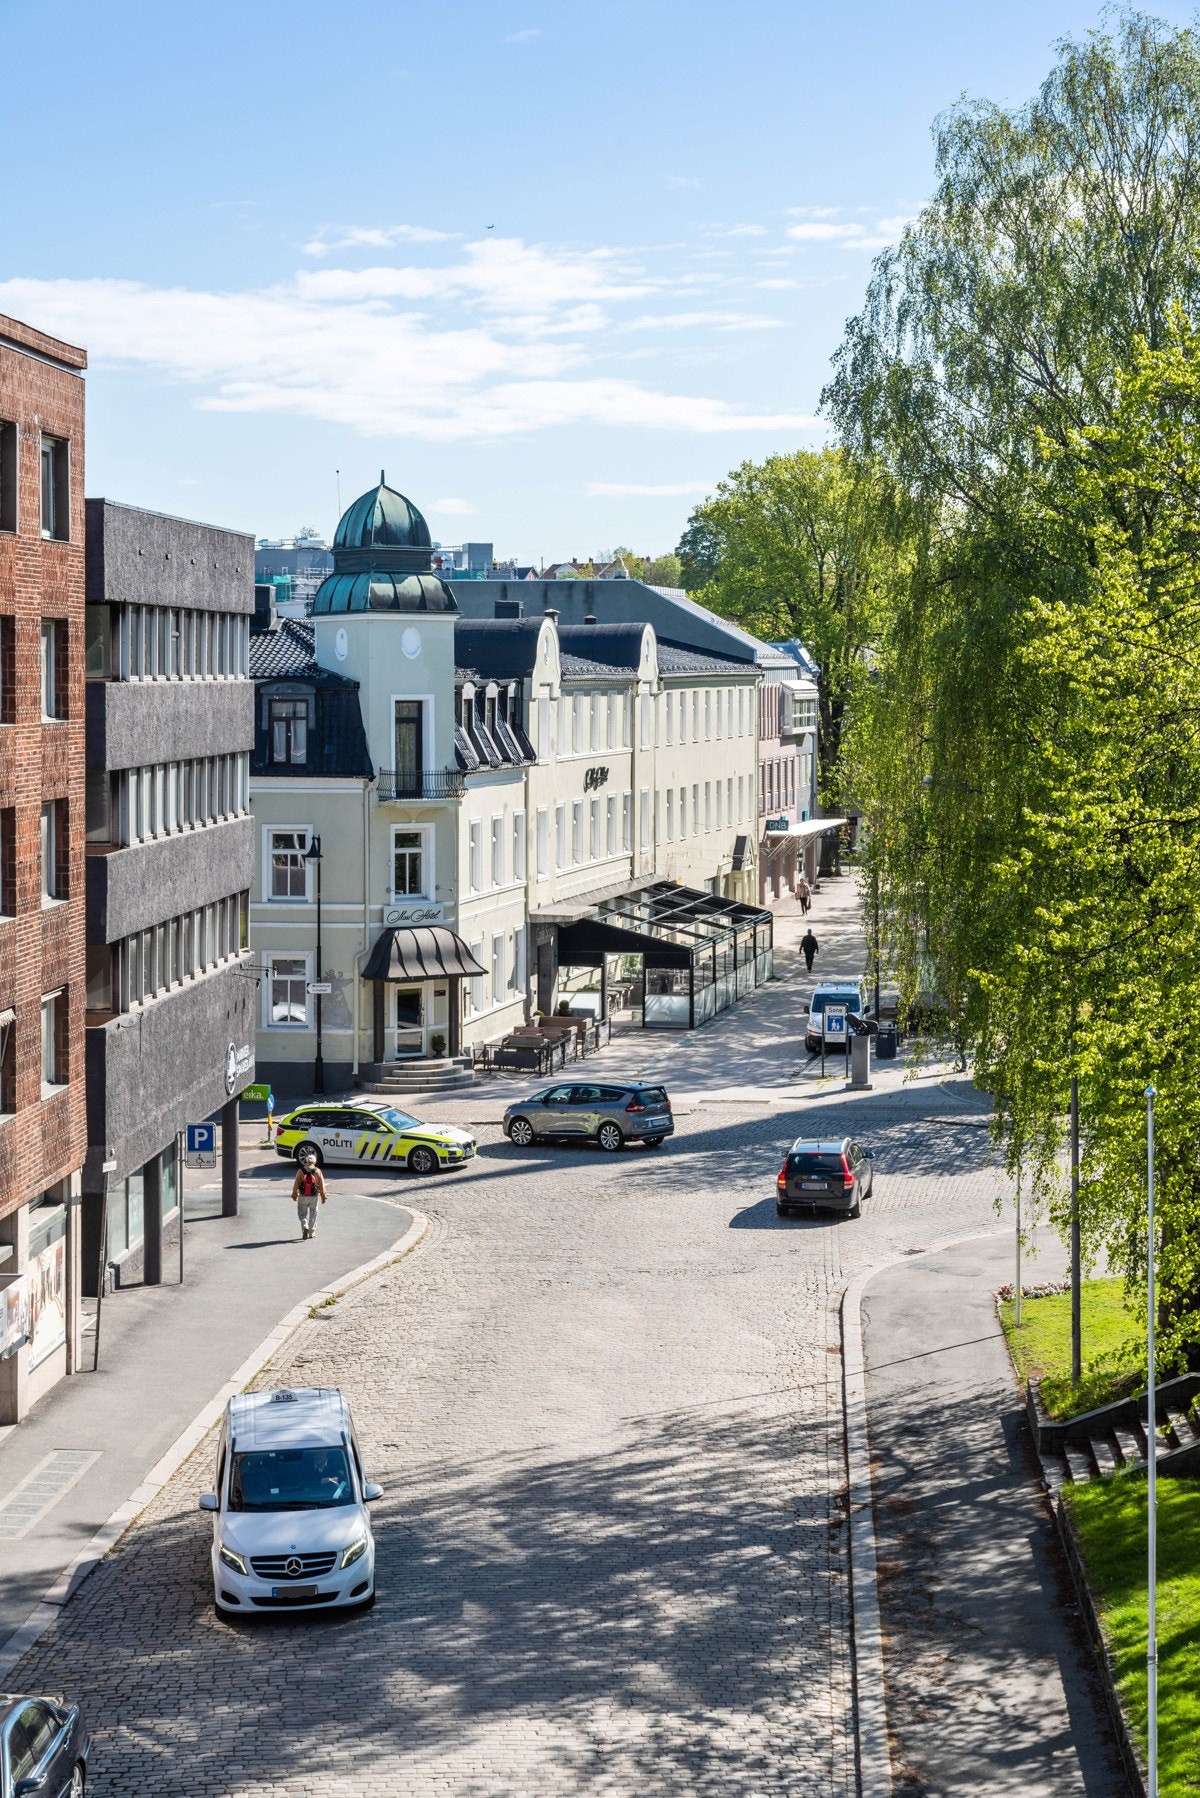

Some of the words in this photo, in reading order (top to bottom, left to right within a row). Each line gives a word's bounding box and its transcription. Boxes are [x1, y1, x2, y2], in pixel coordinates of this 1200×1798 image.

[769, 821, 787, 830] DNB
[411, 909, 441, 923] Hotel
[194, 1128, 209, 1149] P
[323, 1138, 353, 1148] POLITI
